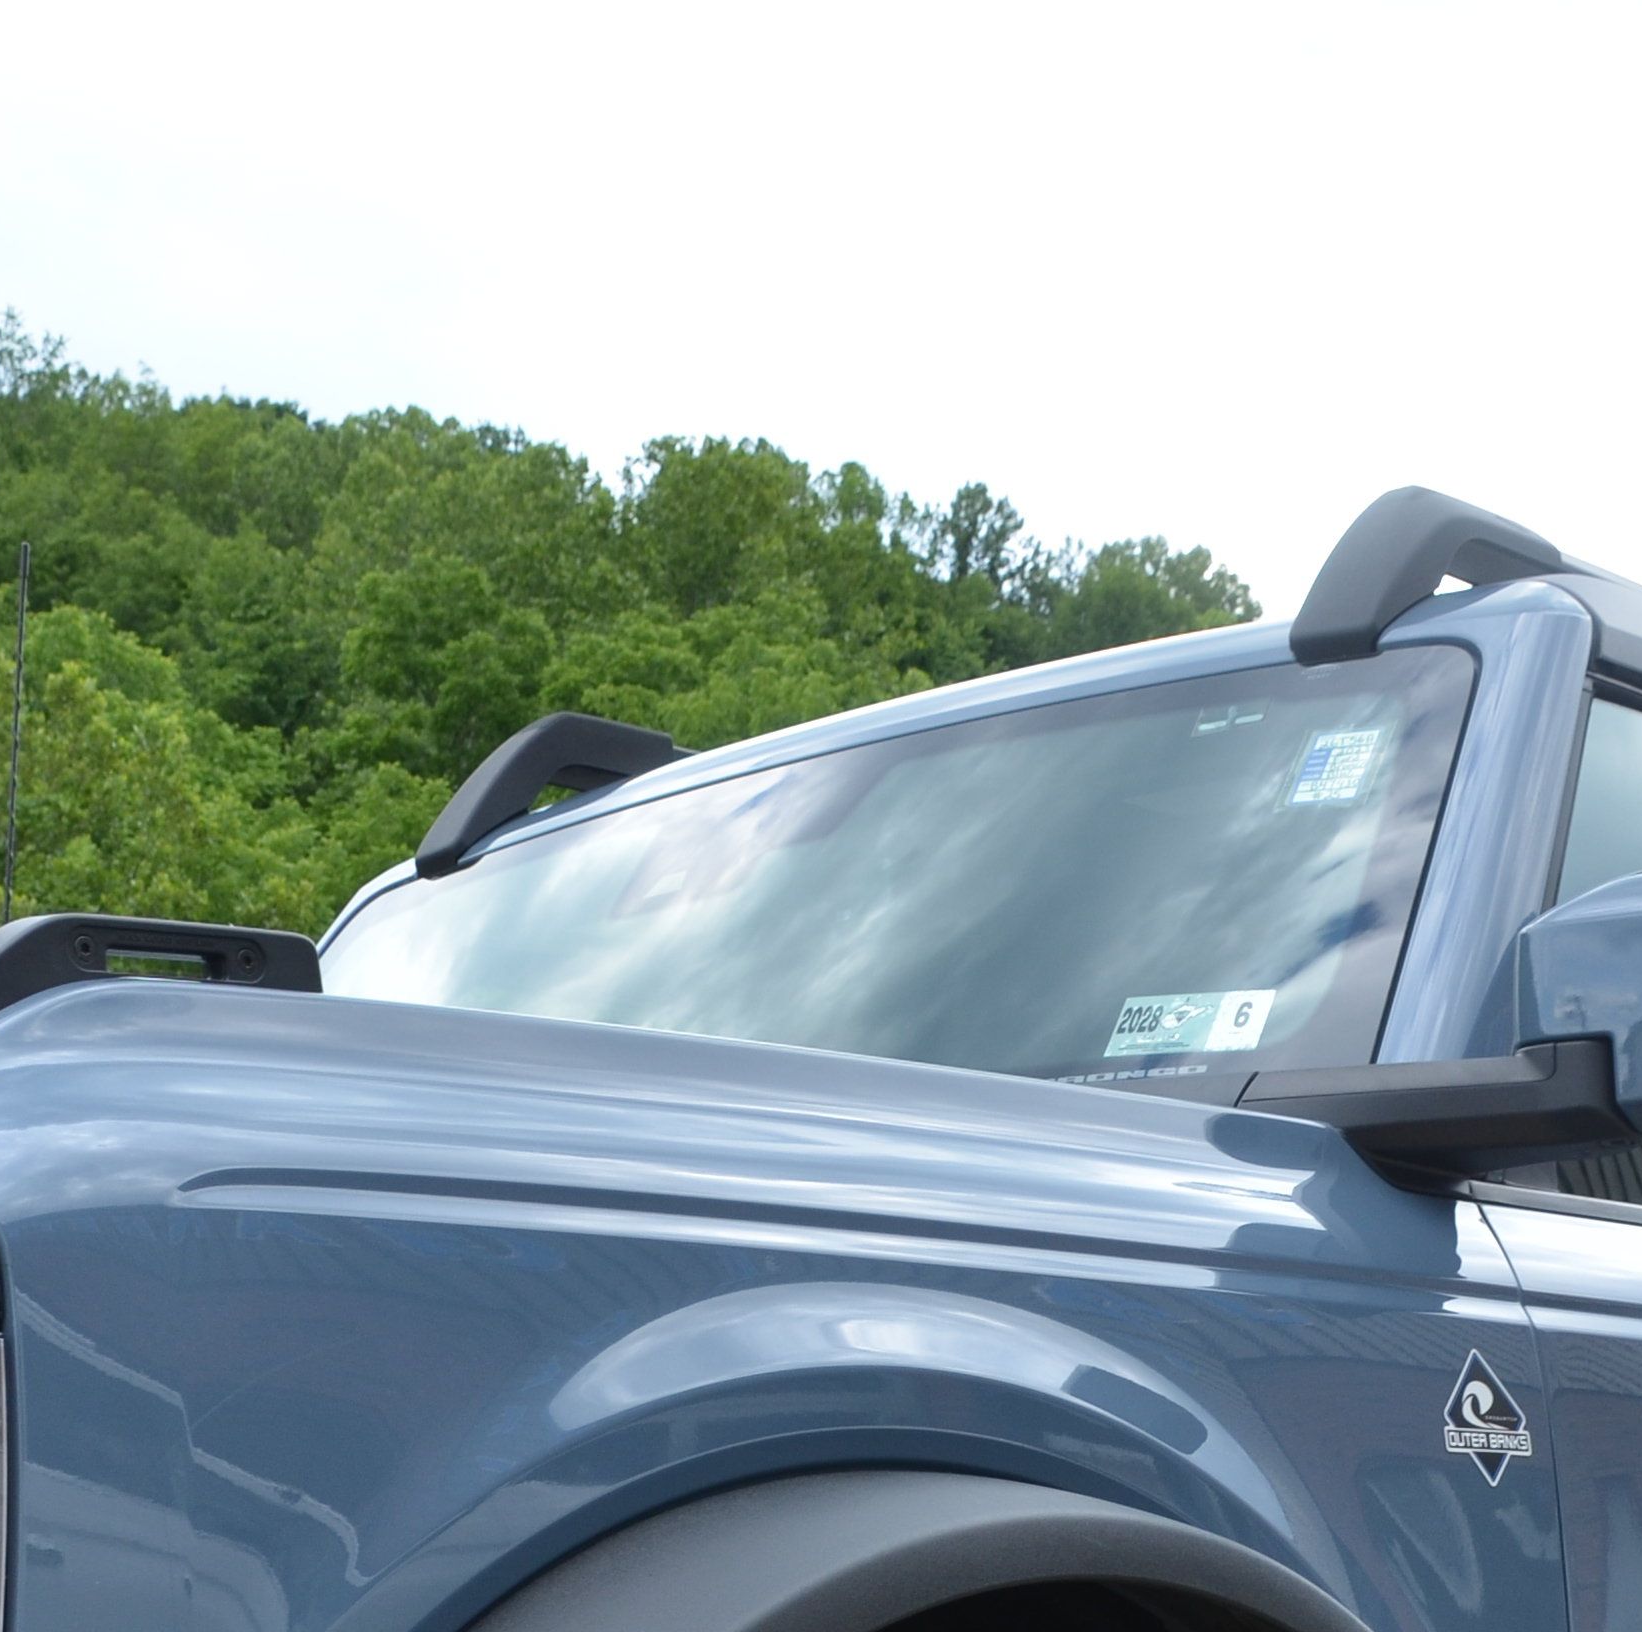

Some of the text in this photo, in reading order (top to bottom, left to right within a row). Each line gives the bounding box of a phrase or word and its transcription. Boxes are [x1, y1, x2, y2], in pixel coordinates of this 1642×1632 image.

[1117, 1001, 1254, 1034] 2028 6
[1045, 1065, 1208, 1083] RONCO
[1449, 1431, 1528, 1450] OUTER BANKS
